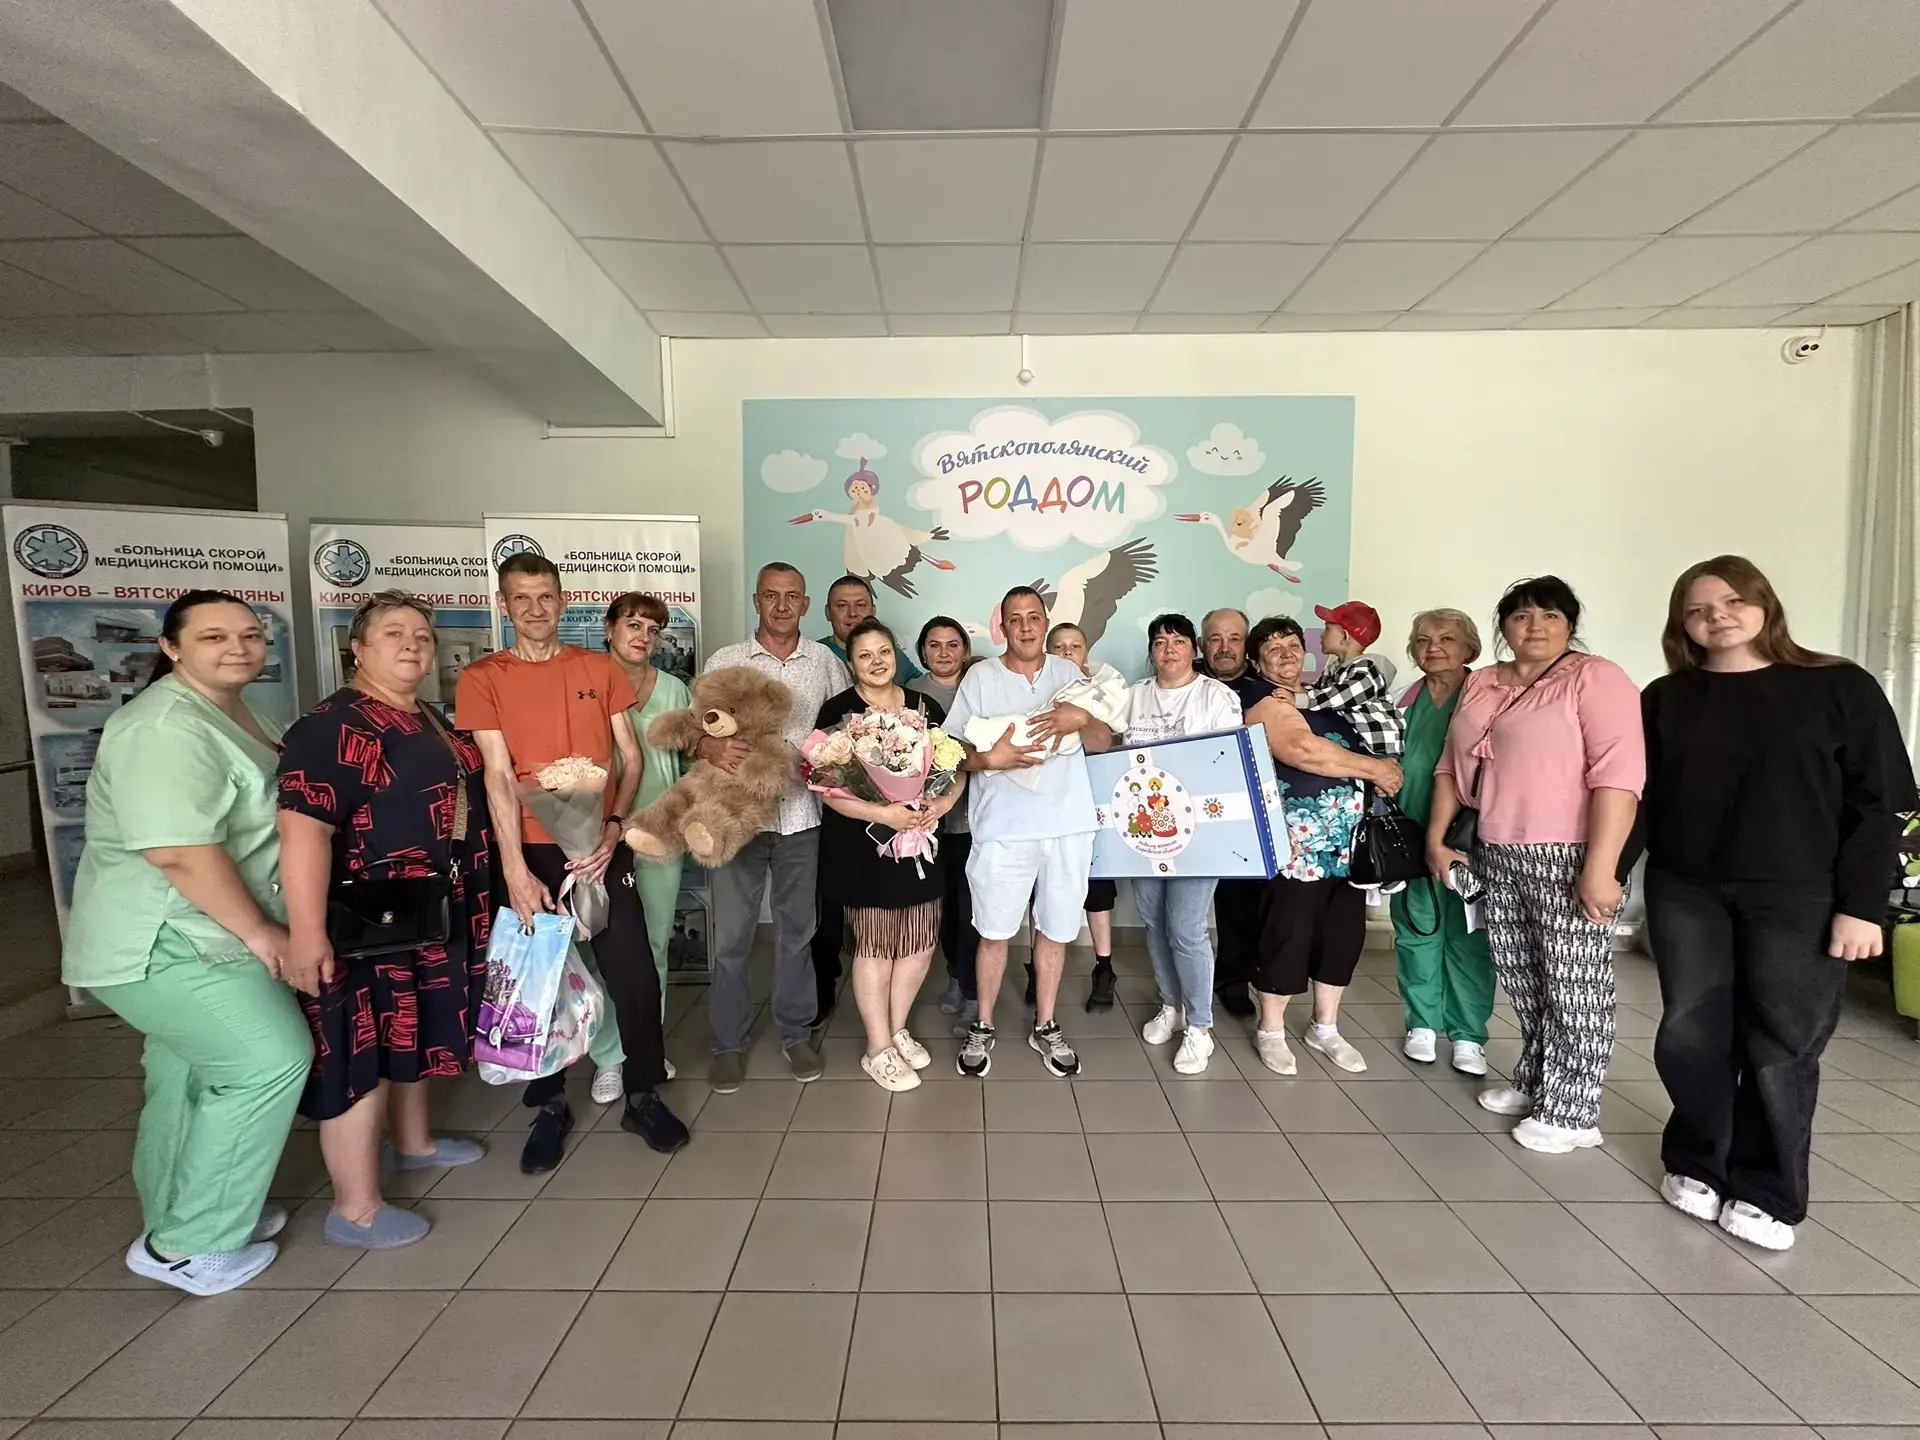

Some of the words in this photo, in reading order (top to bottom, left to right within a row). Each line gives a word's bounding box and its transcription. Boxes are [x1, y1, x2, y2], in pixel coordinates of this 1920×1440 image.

[936, 439, 1150, 474] Вятскополянский
[958, 474, 1126, 514] РОДДОМ
[114, 545, 205, 558] «БОЛЬНИЦА
[208, 547, 266, 560] СКОРОЙ
[564, 551, 634, 562] «БОЛЬНИЦА
[635, 551, 681, 562] СКОРОЙ
[95, 556, 209, 570] МЕДИЦИНСКОЙ
[213, 561, 285, 574] ПОМОЩИ»
[389, 555, 459, 566] «БОЛЬНИЦА
[374, 566, 461, 577] МЕДИЦИНСКОЙ
[638, 564, 696, 575] ПОМОЩИ»
[22, 583, 92, 598] КИРОВ
[114, 586, 196, 599] ВЯТСКИ
[459, 594, 490, 605] ПОЛ
